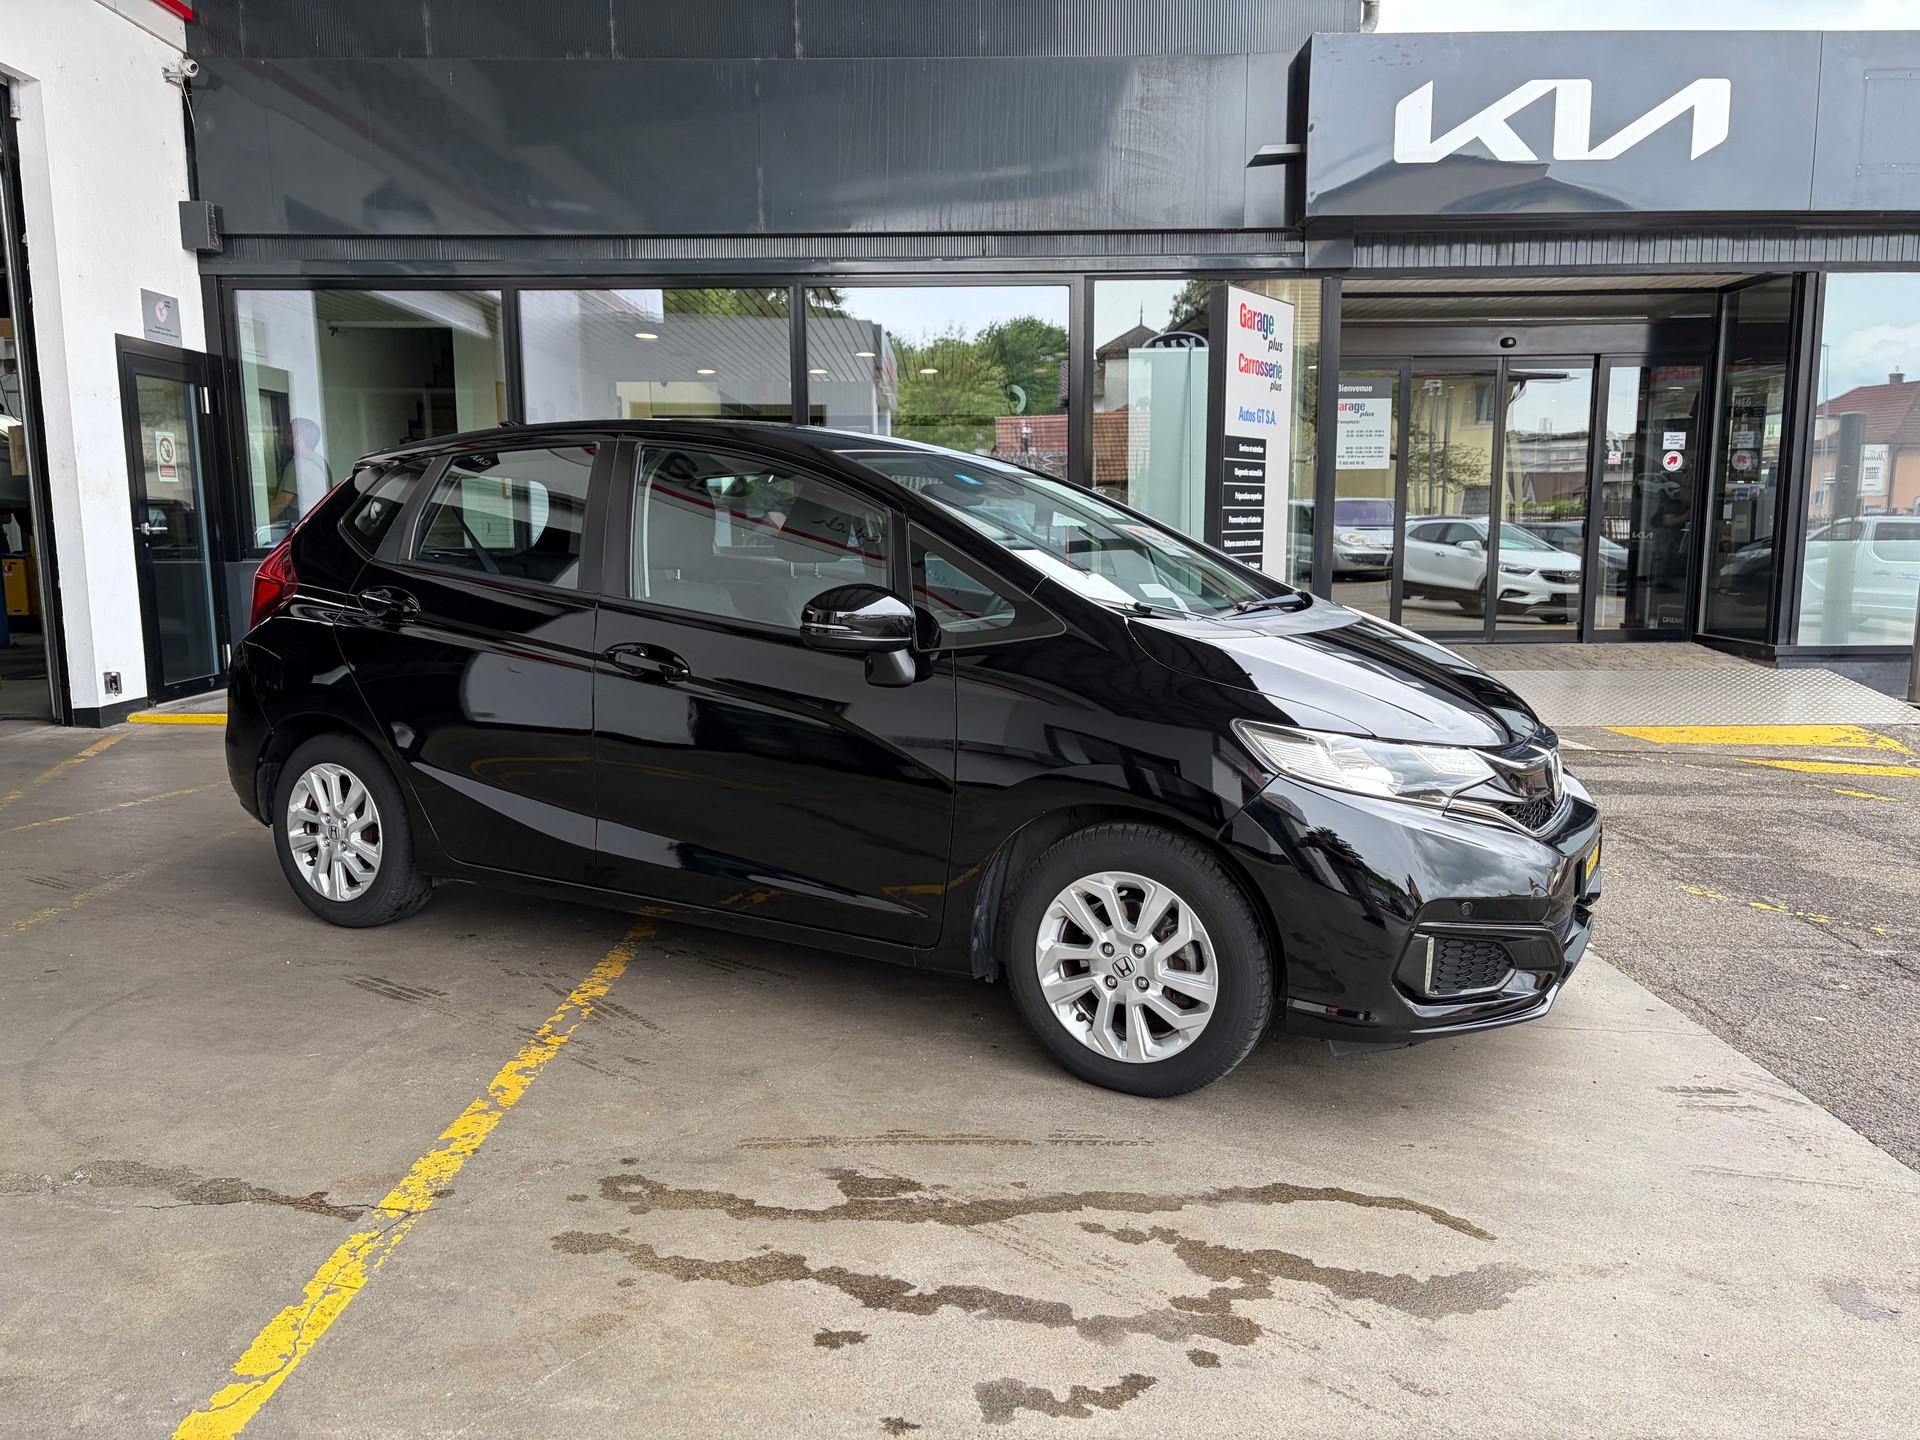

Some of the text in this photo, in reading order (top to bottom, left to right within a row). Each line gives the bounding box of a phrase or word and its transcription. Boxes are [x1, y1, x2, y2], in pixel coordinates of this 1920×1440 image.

[1393, 78, 1732, 164] KIA
[1239, 302, 1274, 341] Garage
[1267, 338, 1283, 353] plus
[1238, 353, 1283, 380] Carrosserie
[1269, 380, 1282, 393] plus
[1238, 406, 1256, 423] Autos
[1256, 408, 1265, 424] GT
[1337, 402, 1366, 413] arage
